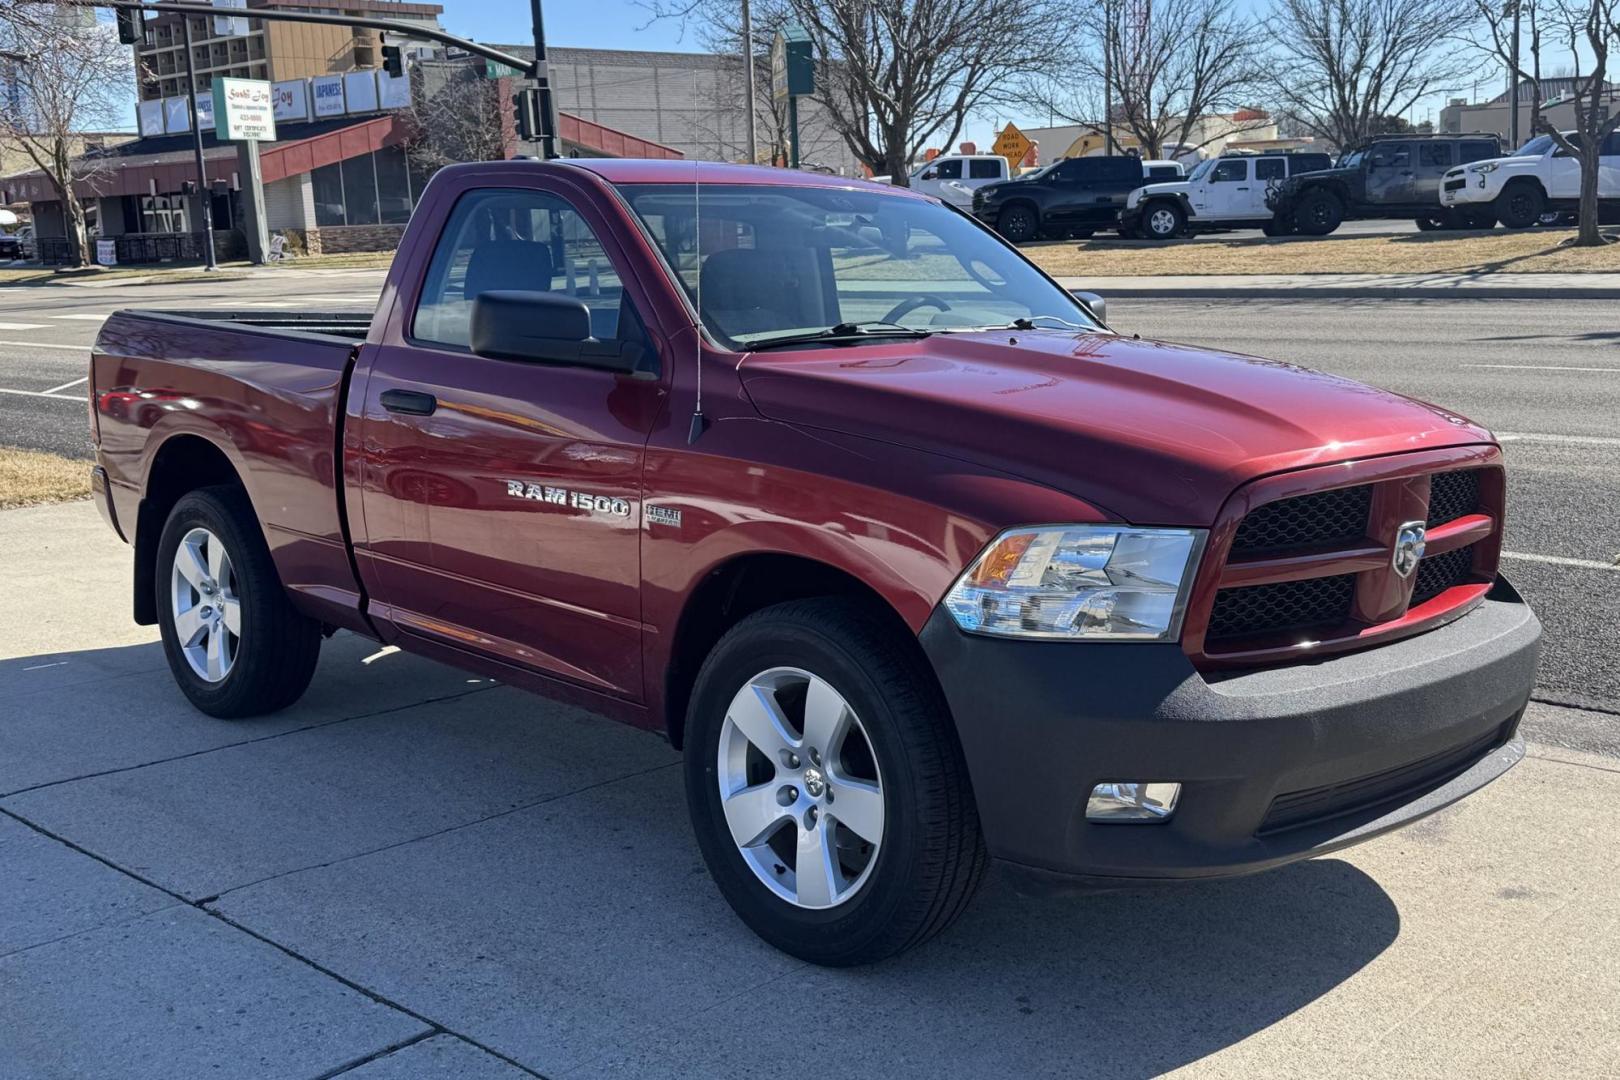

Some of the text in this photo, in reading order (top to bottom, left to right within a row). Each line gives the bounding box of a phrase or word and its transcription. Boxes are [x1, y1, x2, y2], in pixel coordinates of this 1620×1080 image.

[228, 88, 269, 103] Sushi Joy
[316, 83, 342, 98] JAPANESE
[508, 480, 631, 517] RAM 1500
[646, 504, 682, 521] HEMI
